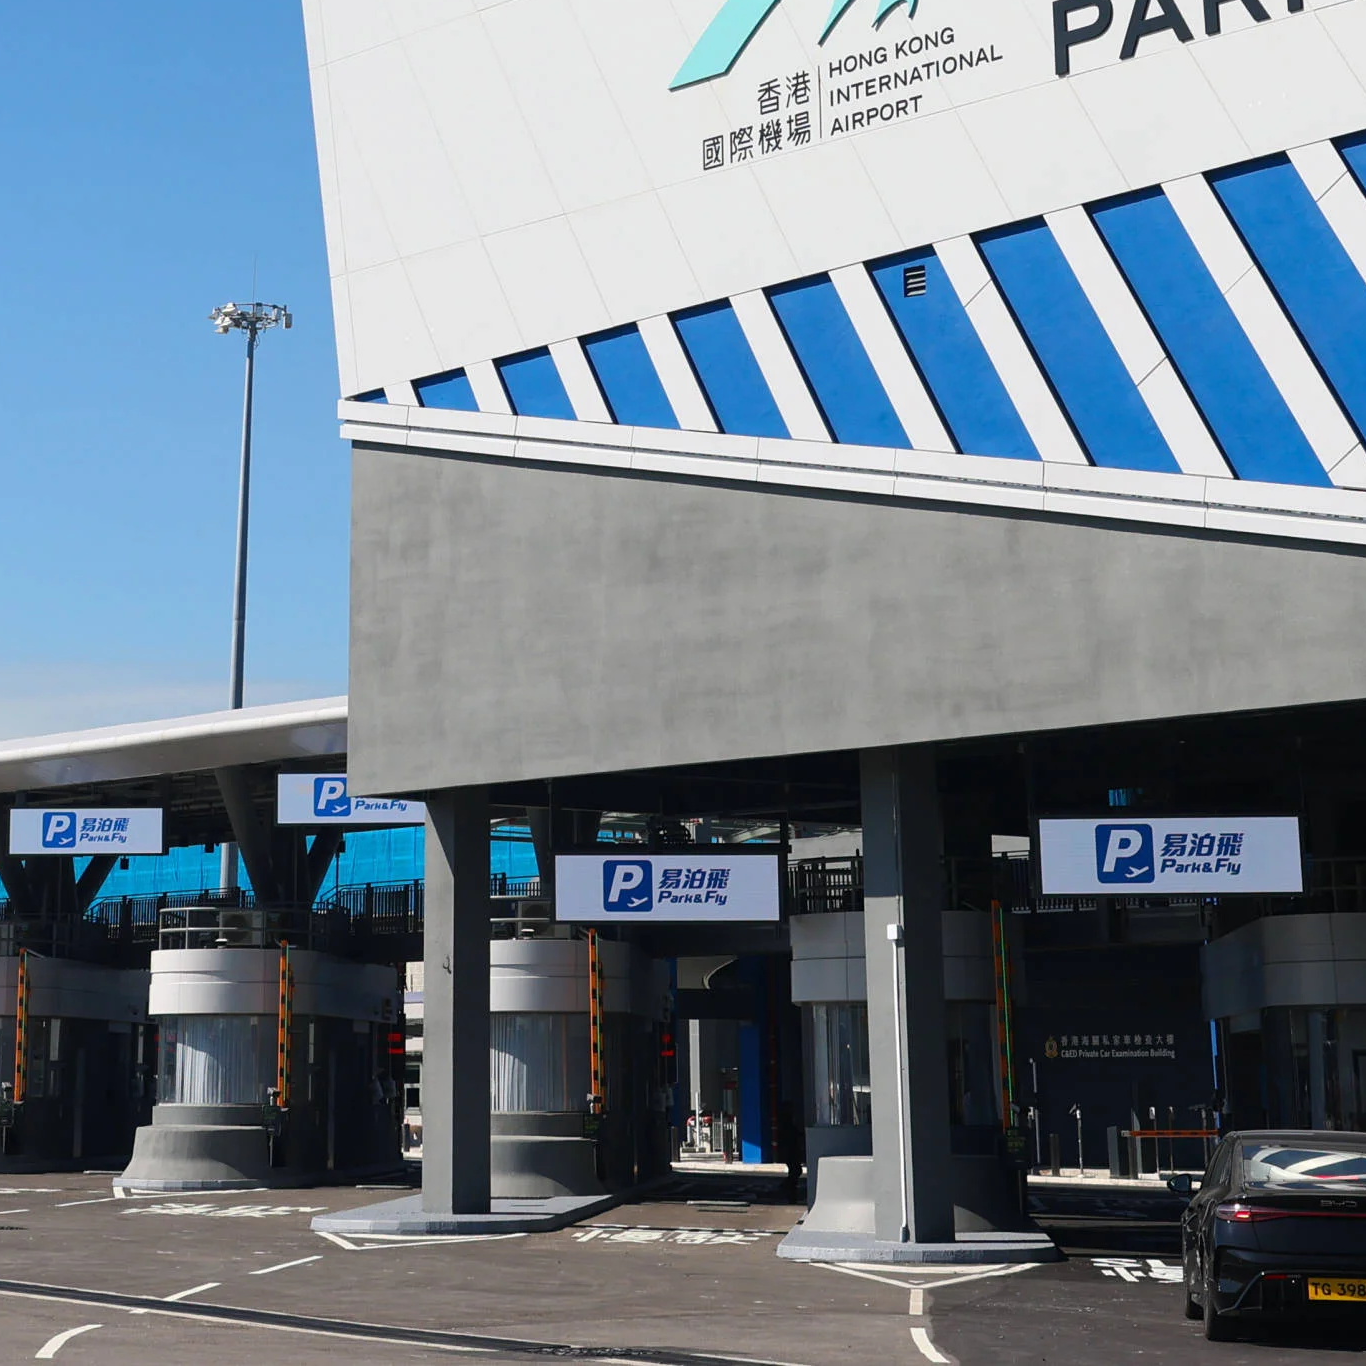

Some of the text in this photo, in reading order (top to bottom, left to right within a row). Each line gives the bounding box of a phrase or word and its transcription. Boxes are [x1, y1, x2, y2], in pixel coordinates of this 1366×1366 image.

[829, 27, 955, 78] HONG KONG
[830, 45, 1003, 107] INTERNATIONAL
[757, 70, 811, 116] 香港
[830, 94, 923, 136] AIRPORT
[702, 111, 811, 171] 國際機場
[317, 781, 344, 809] P
[355, 800, 407, 811] Park&Fly
[45, 815, 71, 841] P
[79, 818, 130, 832] 易泊飛
[79, 832, 127, 843] Park&Fly
[1102, 829, 1143, 873] P
[1160, 833, 1245, 857] 易泊飛
[657, 868, 731, 889] 易泊飛
[1160, 858, 1241, 875] Park&Fly
[607, 864, 644, 902] P
[657, 890, 728, 906] Park&Fly
[1078, 1049, 1099, 1058] Private
[1100, 1049, 1110, 1058] Car
[1111, 1049, 1149, 1058] Examination
[1150, 1048, 1175, 1059] Building
[1310, 1282, 1332, 1296] TG
